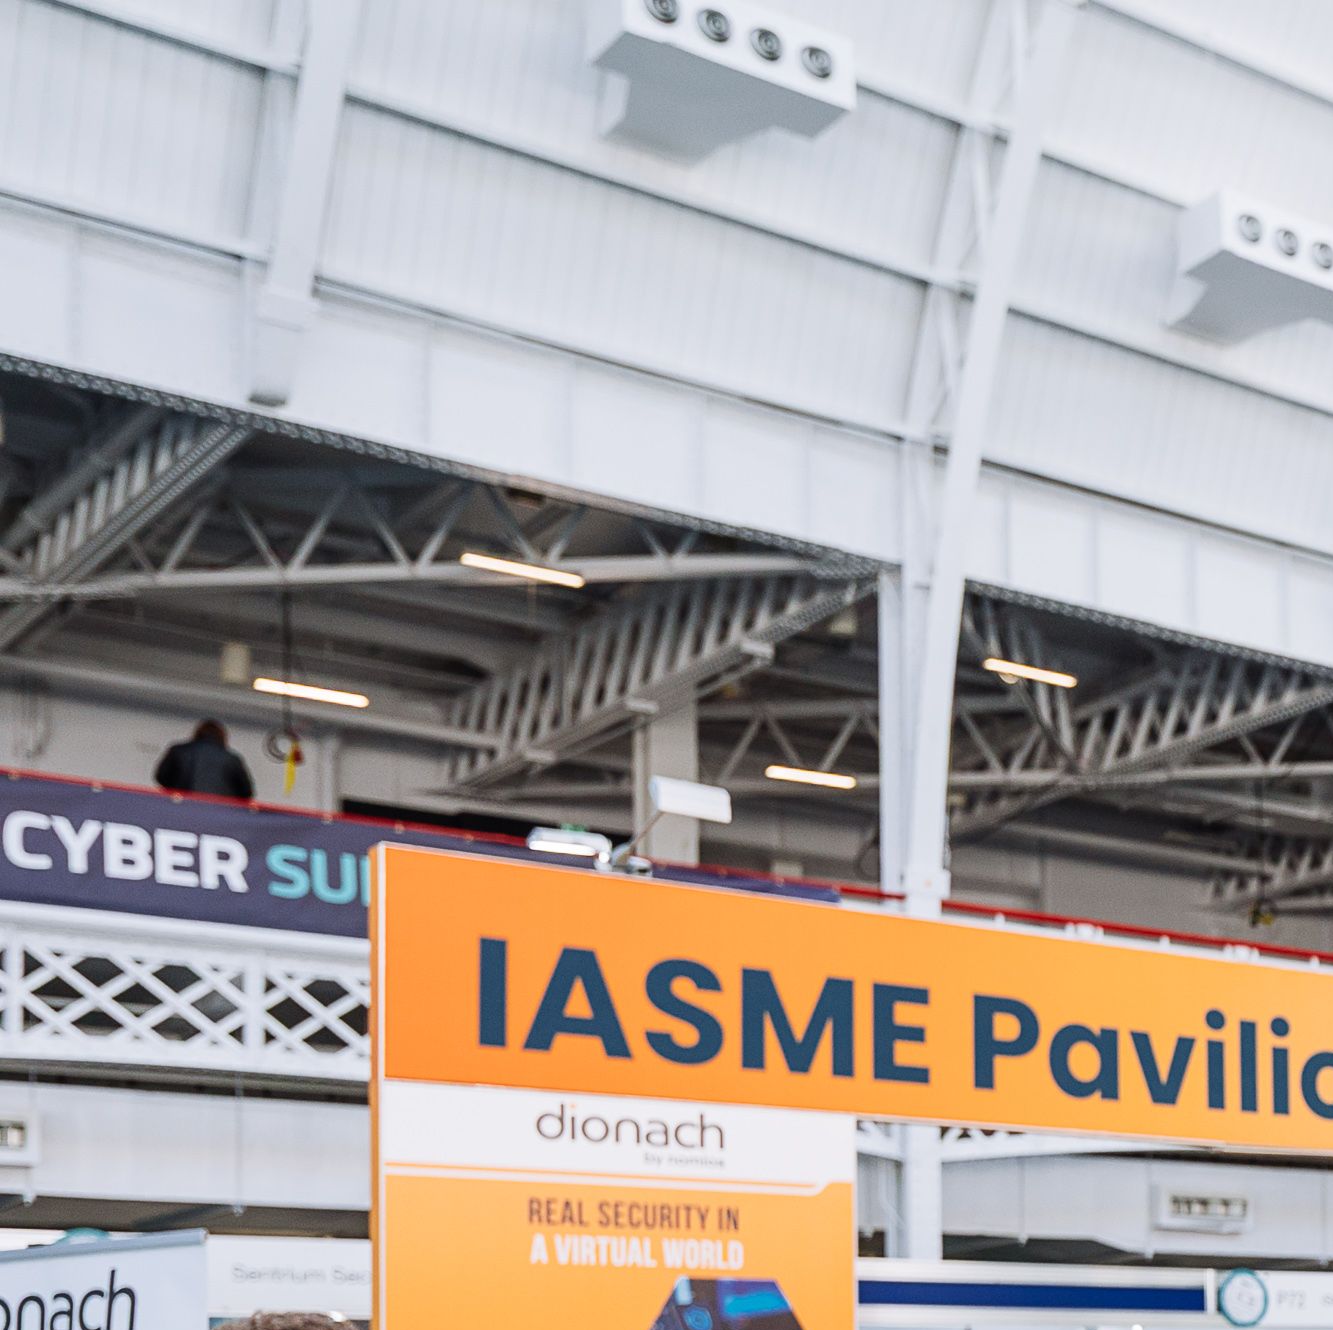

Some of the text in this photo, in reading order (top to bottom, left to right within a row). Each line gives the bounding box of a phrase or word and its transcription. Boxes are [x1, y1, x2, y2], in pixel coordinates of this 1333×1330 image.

[3, 809, 370, 905] CYBER SU
[478, 937, 930, 1085] IASME
[536, 1103, 724, 1149] dionach
[528, 1197, 740, 1232] REAL SECURITY IN
[530, 1233, 745, 1270] A VIRTUAL WORLD
